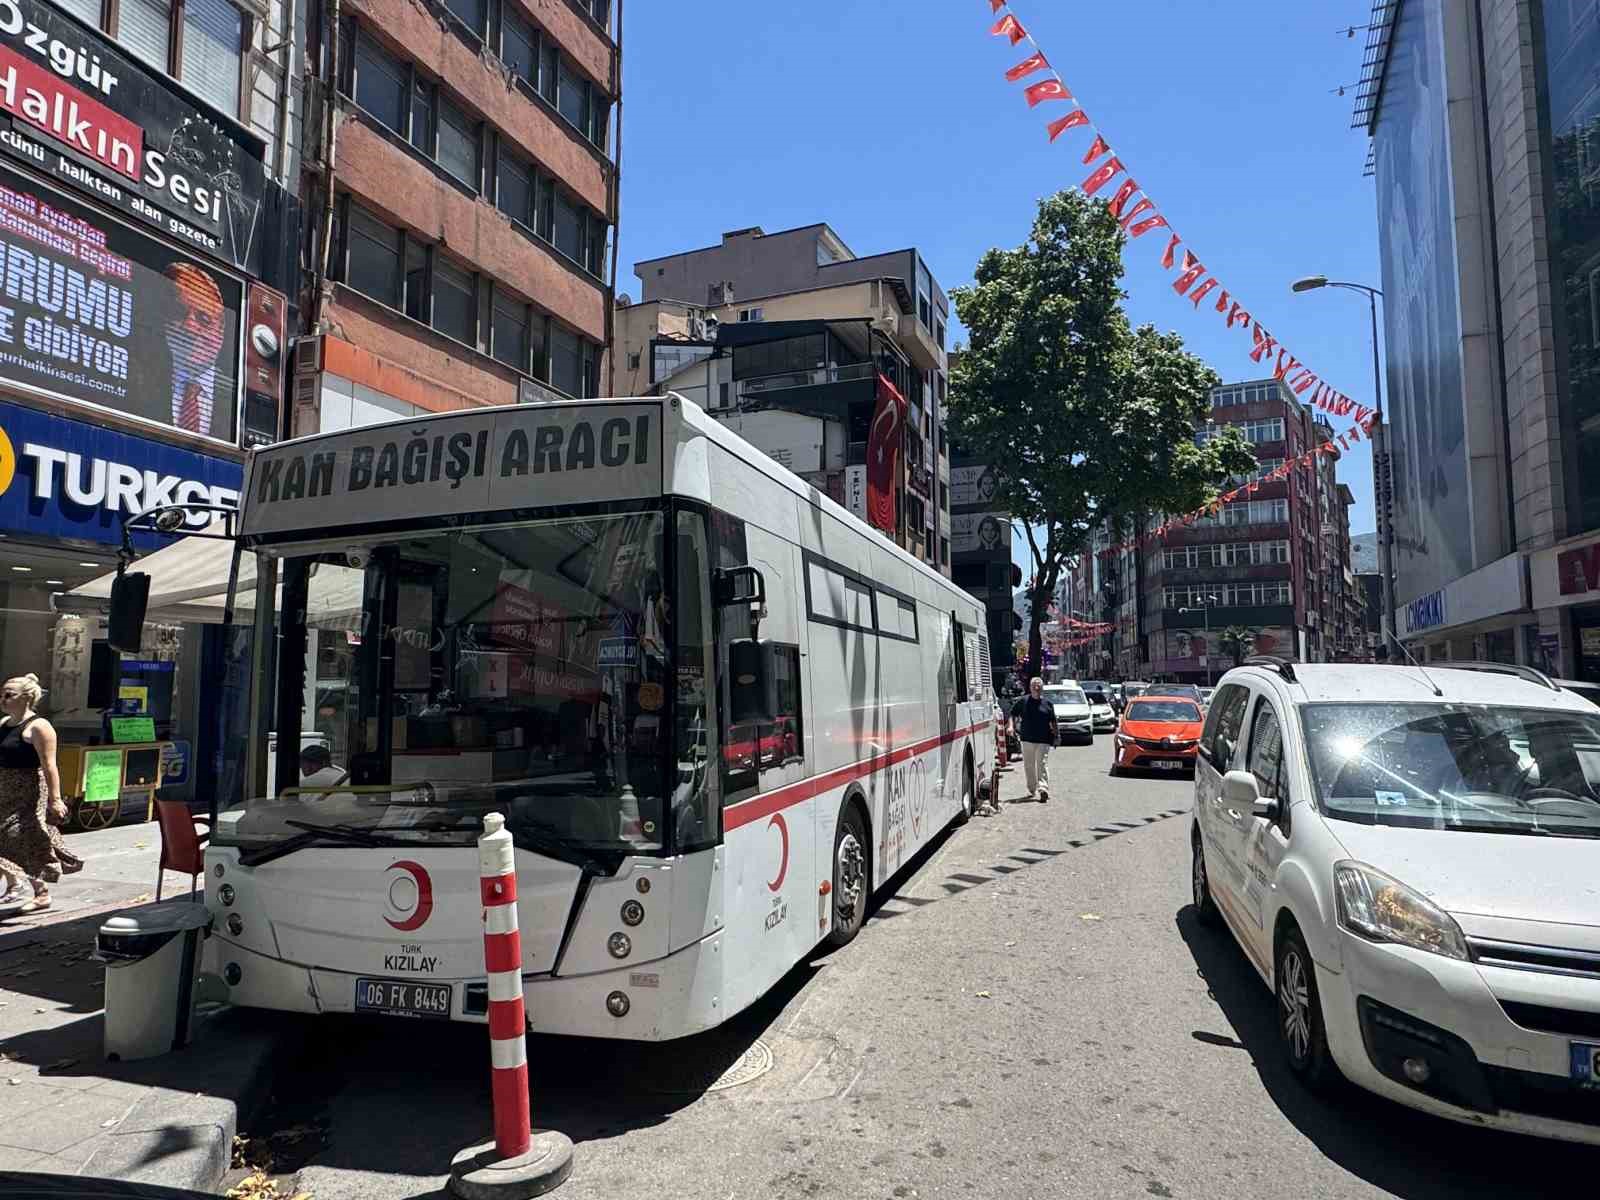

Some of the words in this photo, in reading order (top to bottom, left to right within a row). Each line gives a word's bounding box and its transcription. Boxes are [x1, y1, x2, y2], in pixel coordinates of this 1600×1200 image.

[59, 157, 122, 201] halktan
[131, 197, 163, 223] alan
[145, 149, 222, 223] Sesi
[0, 240, 133, 338] RUMU
[24, 315, 129, 381] GİDİYOR
[24, 442, 242, 527] TURKCE
[258, 451, 336, 504] KAN
[348, 428, 489, 490] BAĞIŞI
[500, 414, 650, 478] ARACI
[367, 983, 384, 1005] 06
[390, 986, 407, 1008] FK
[414, 988, 447, 1011] 8449
[384, 955, 437, 973] KIZILAY
